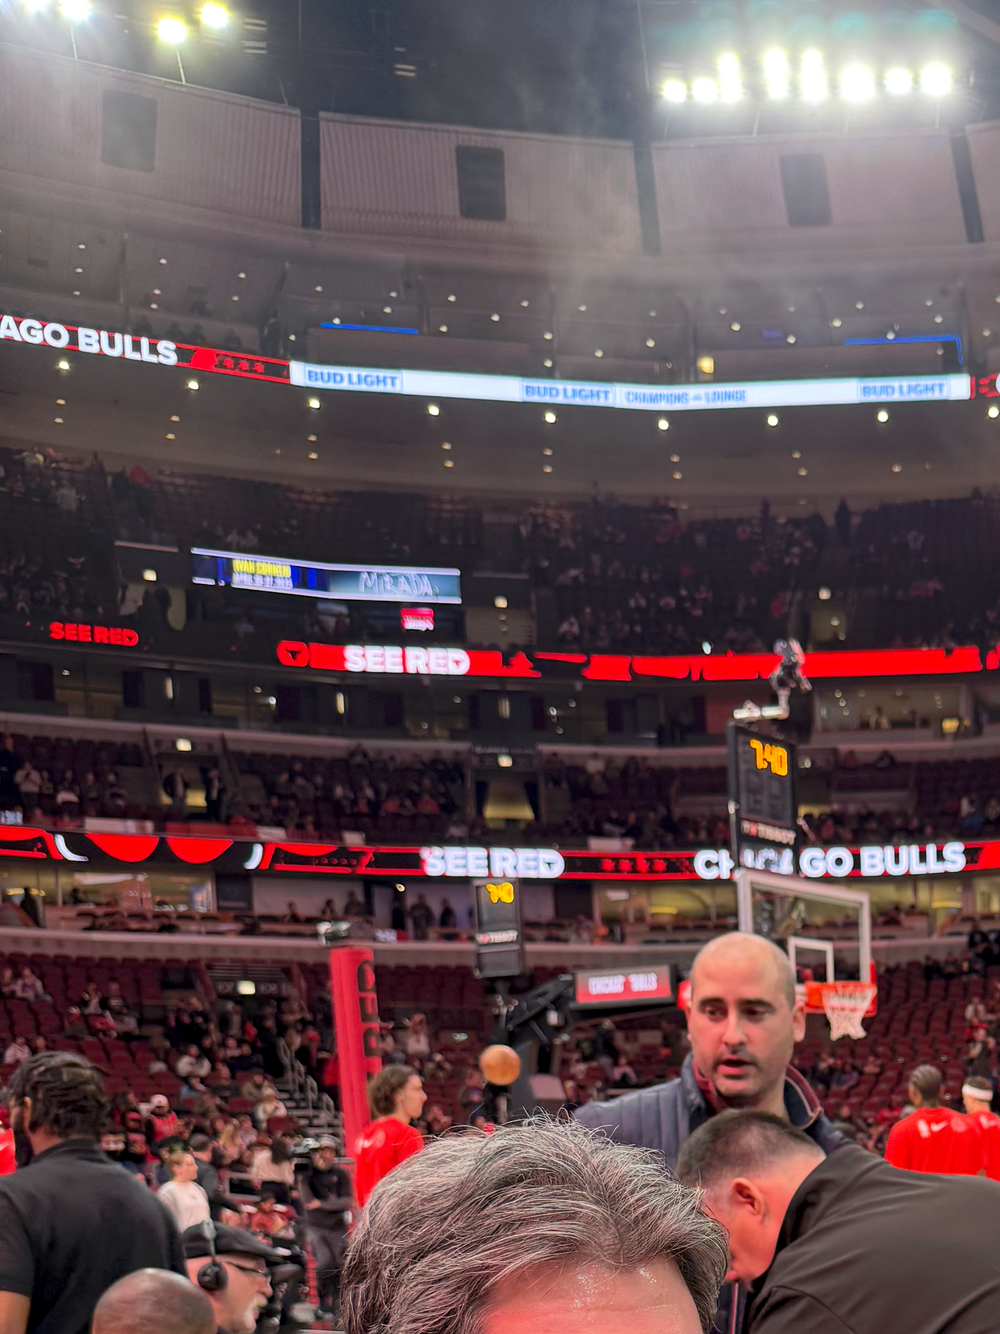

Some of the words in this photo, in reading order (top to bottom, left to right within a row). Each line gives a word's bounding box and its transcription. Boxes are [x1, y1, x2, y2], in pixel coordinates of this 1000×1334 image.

[77, 326, 178, 366] BULLS
[307, 369, 345, 386] BUD
[347, 372, 398, 389] LIGHT
[862, 383, 895, 398] BUD
[900, 382, 947, 397] LIGHT
[524, 384, 559, 399] BUD
[562, 386, 610, 403] LIGHT
[50, 621, 92, 642] SEE
[93, 626, 139, 646] RED
[344, 645, 402, 673] SEE
[404, 648, 471, 675] RED
[421, 846, 489, 877] SEE
[490, 847, 565, 879] RED
[860, 841, 967, 877] BULLS
